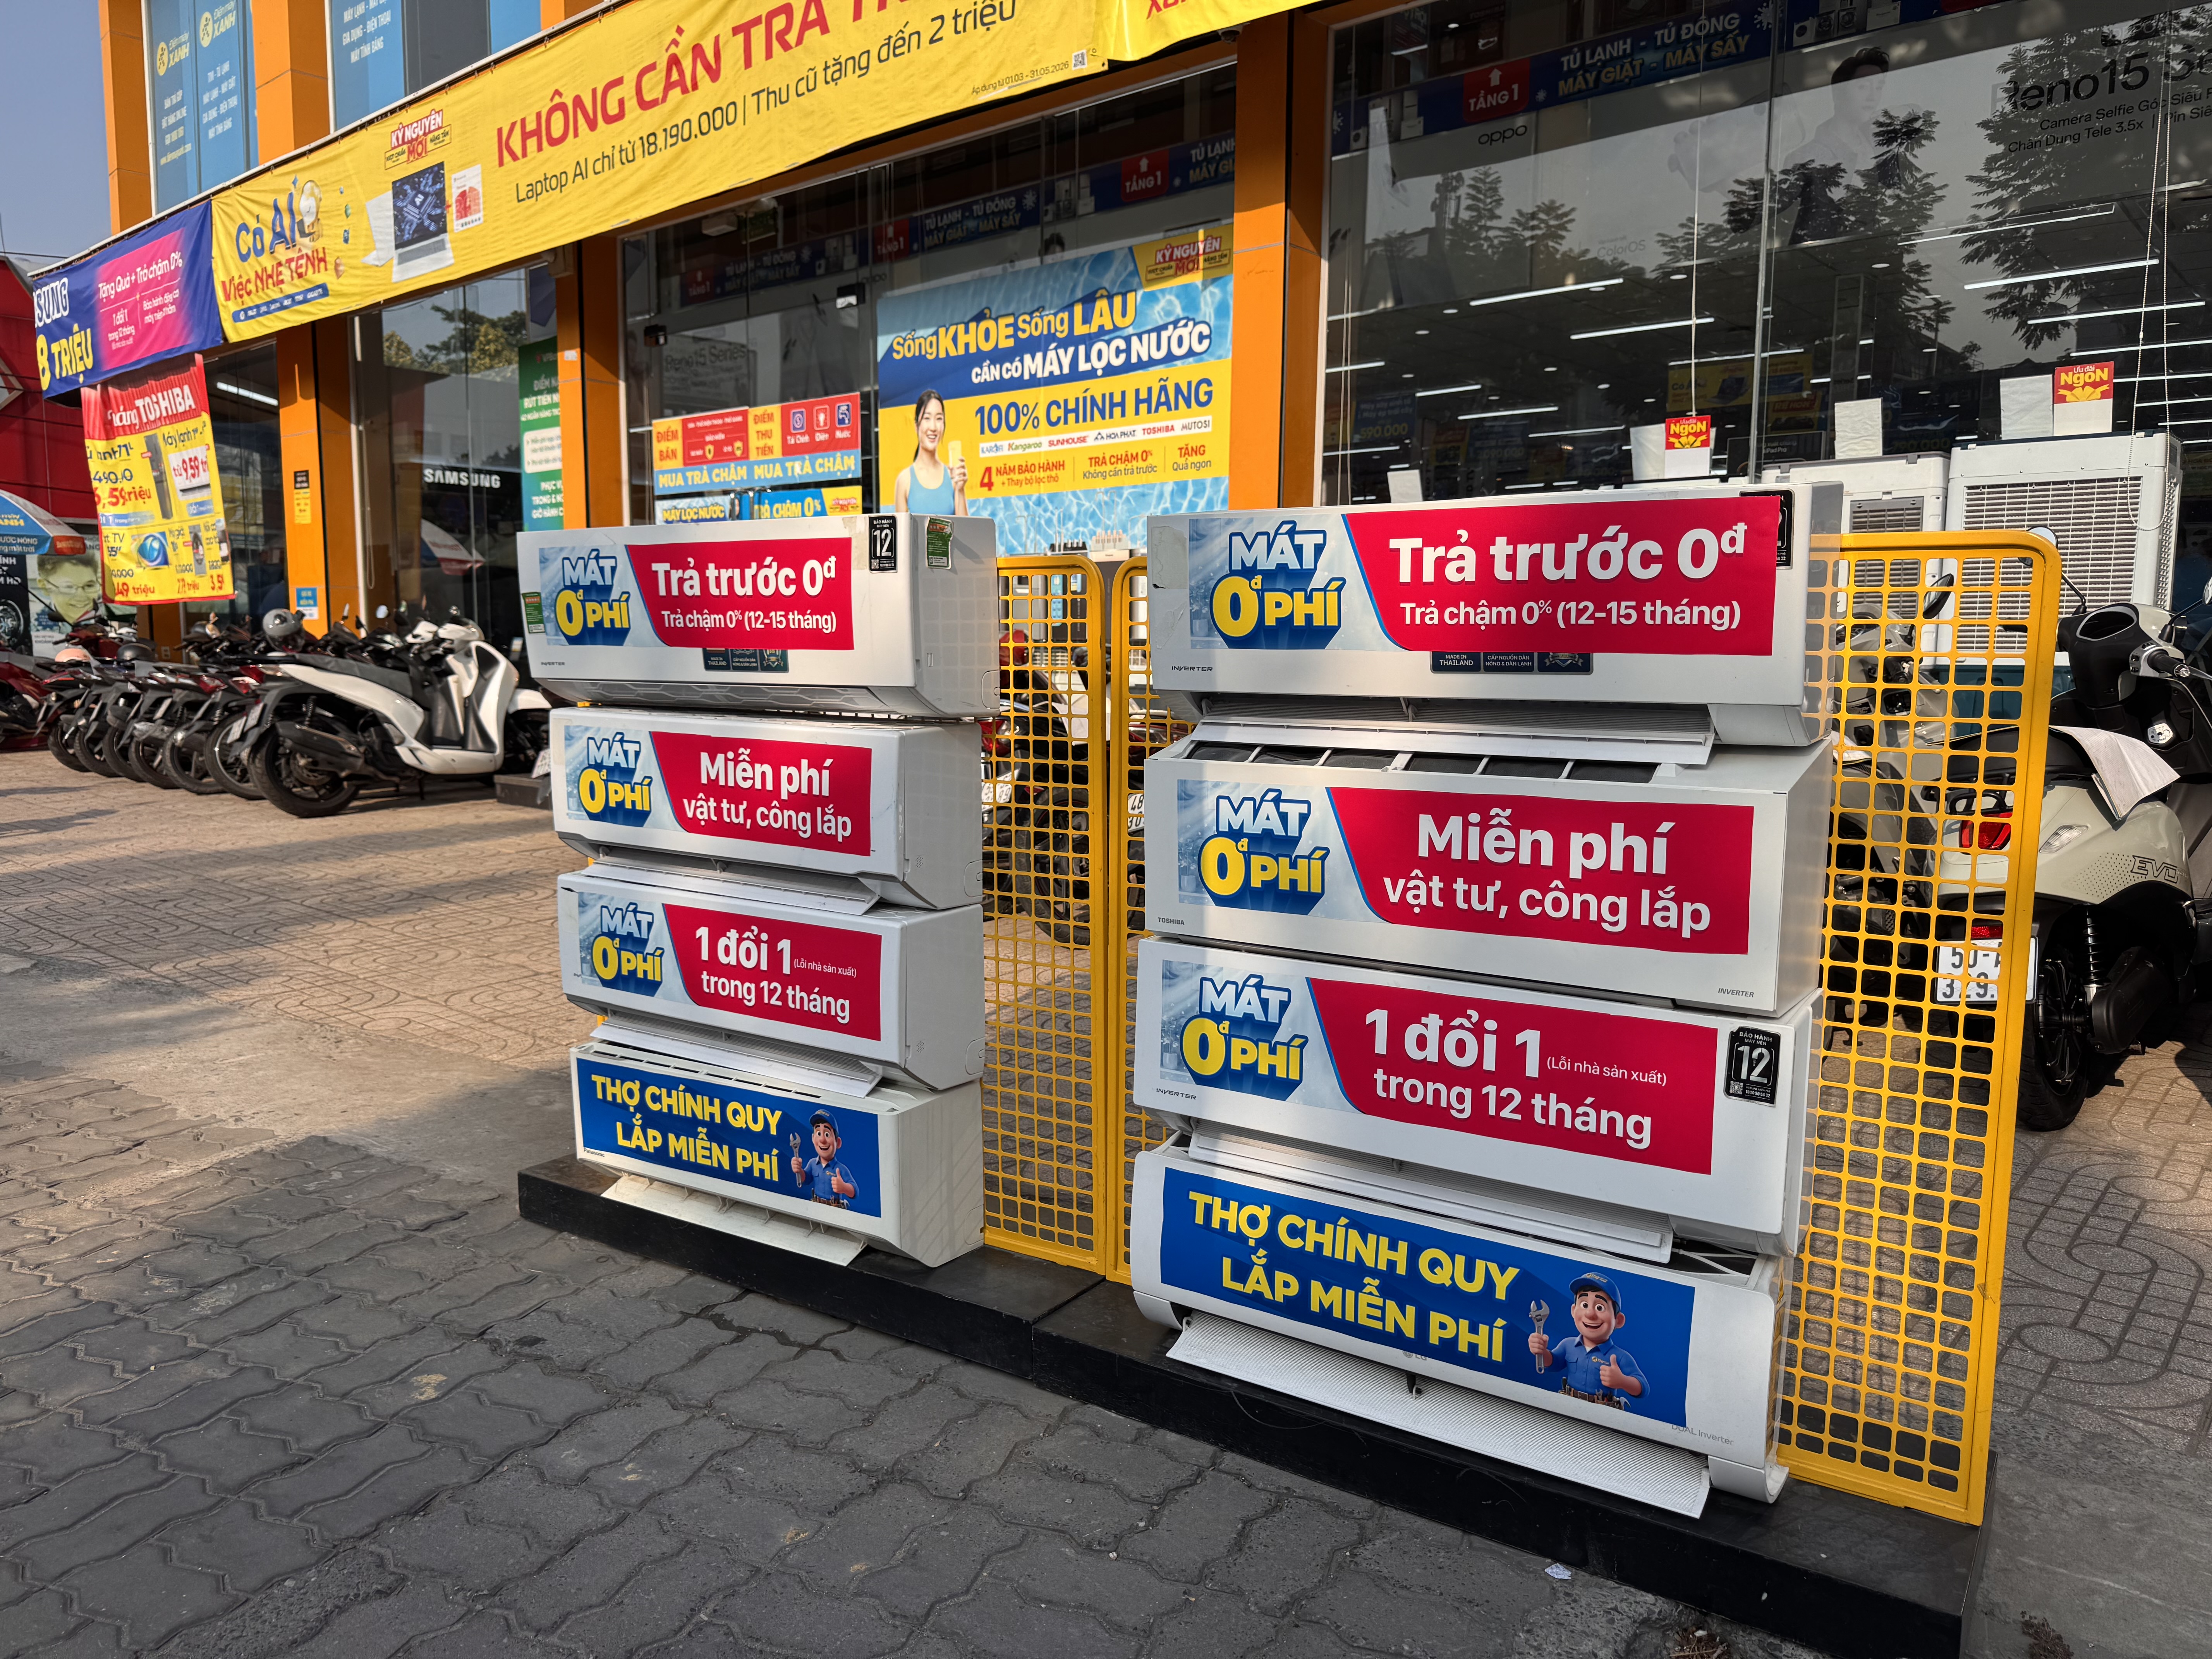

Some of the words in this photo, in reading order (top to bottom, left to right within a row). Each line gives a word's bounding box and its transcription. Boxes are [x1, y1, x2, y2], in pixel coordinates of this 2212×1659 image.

[1561, 48, 1580, 72] TỦ
[1585, 38, 1632, 65] LẠNH
[1654, 22, 1676, 46] TỦ
[1680, 12, 1740, 40] ĐÔNG
[1029, 61, 1069, 78] 31.05.2026
[1558, 72, 1597, 97] MÁY
[1600, 58, 1644, 84] GIẶT
[1665, 45, 1704, 69] MÁY
[1711, 29, 1751, 58] SẤY
[496, 76, 626, 168] KHÔNG
[635, 24, 721, 111] CẦN
[516, 170, 568, 203] Laptop
[572, 158, 588, 184] AI
[592, 146, 615, 175] chỉ
[619, 139, 636, 166] từ
[639, 102, 737, 159] 18.190.000
[751, 82, 790, 115] Thu
[795, 68, 818, 98] cũ
[823, 49, 870, 86] tặng
[878, 21, 921, 64] đến
[929, 15, 945, 45] 2
[953, 0, 1016, 34] triệu
[1469, 89, 1509, 112] TẦNG
[1511, 83, 1518, 101] 1
[2040, 113, 2091, 131] Camera
[2095, 103, 2134, 120] Selfie
[2138, 96, 2167, 112] Góc
[2171, 86, 2202, 106] Siêu
[404, 110, 443, 142] NGUYÊN
[1478, 124, 1527, 145] oppo
[2008, 139, 2042, 153] Chân
[2045, 131, 2081, 146] Dung
[2085, 122, 2111, 139] Tele
[2115, 118, 2144, 134] 3.5x
[2164, 110, 2186, 126] Pin
[236, 214, 265, 263] Có
[269, 191, 297, 254] AI
[1172, 236, 1221, 258] NGUYÊN
[98, 282, 115, 302] Tặng
[116, 271, 131, 292] Quà
[136, 263, 148, 284] Trả
[148, 258, 170, 280] chậm
[170, 251, 182, 270] 0%
[222, 274, 252, 306] Việc
[255, 261, 285, 294] NHẸ
[285, 247, 328, 279] TÊNH
[33, 277, 69, 328] SUNG
[892, 329, 938, 360] Sống
[938, 307, 1015, 358] KHỎE
[1017, 306, 1069, 338] Sống
[1073, 289, 1137, 336] LÂU
[51, 323, 94, 384] TRIỆU
[971, 361, 1000, 384] CẦN
[1001, 359, 1021, 378] CÓ
[1023, 343, 1075, 380] MÁY
[1078, 339, 1127, 376] LỌC
[1130, 319, 1211, 364] NƯỚC
[2060, 368, 2108, 387] NgoN
[135, 384, 196, 423] TOSHIBA
[753, 408, 775, 425] ĐIỂM
[975, 401, 1040, 435] 100%
[1046, 387, 1127, 427] CHÍNH
[1134, 377, 1214, 416] HÃNG
[656, 426, 679, 443] ĐIỂM
[756, 429, 773, 441] THU
[1142, 424, 1175, 435] TOSHIBA
[1181, 420, 1211, 431] MUTOSI
[1670, 421, 1707, 436] NgoN
[659, 447, 677, 461] BÁN
[756, 443, 774, 458] TIỀN
[1008, 440, 1042, 452] Kangaroo
[1048, 436, 1089, 447] SUNHOUSE
[1178, 443, 1206, 460] TẶNG
[1083, 468, 1107, 481] Không
[1108, 466, 1122, 477] cần
[1123, 464, 1135, 476] trả
[1136, 463, 1157, 475] trước
[1088, 455, 1108, 468] TRẢ
[1109, 451, 1139, 467] CHẬM
[1190, 460, 1212, 471] ngon
[424, 468, 501, 488] SAMSUNG
[659, 473, 684, 488] MUA
[686, 465, 710, 485] TRẢ
[712, 462, 747, 485] CHẬM
[980, 466, 994, 491] 4
[996, 464, 1017, 477] NĂM
[1017, 461, 1037, 474] BẢO
[1037, 460, 1065, 472] HÀNH
[1006, 476, 1024, 487] Thay
[663, 504, 681, 522] MÁY
[682, 507, 698, 523] LỌC
[698, 503, 725, 519] NƯỚC
[873, 529, 892, 557] 12
[1232, 524, 1324, 570] MÁT
[1389, 529, 1476, 583] Trả
[1490, 525, 1662, 581] trước
[1677, 522, 1748, 580] 0đ
[1264, 580, 1344, 627] PHÍ
[1400, 599, 1439, 625] Trả
[1443, 602, 1516, 630] chậm
[1522, 600, 1553, 625] 0%
[1556, 601, 1638, 629] (12-15
[1642, 598, 1741, 630] tháng)
[1417, 807, 1553, 867] Miễn
[1569, 822, 1676, 879] phí
[2130, 855, 2179, 884] EVO
[1383, 869, 1444, 913] vật
[1453, 877, 1508, 919] tư,
[1519, 881, 1627, 932] công
[1640, 885, 1710, 938] lắp
[1157, 917, 1185, 926] TOSHIBA
[793, 957, 807, 970] (Lỗi
[807, 960, 821, 971] nhà
[822, 962, 836, 974] sản
[837, 964, 857, 979] xuất)
[1717, 988, 1754, 998] INVERTER
[1365, 1009, 1388, 1055] 1
[1404, 1009, 1497, 1072] đổi
[1515, 1029, 1540, 1079] 1
[1547, 1056, 1571, 1072] (Lỗi
[1573, 1058, 1601, 1075] nhà
[1602, 1063, 1628, 1079] sản
[1631, 1067, 1667, 1087] xuất)
[1754, 1034, 1772, 1042] HÀNH
[1737, 1045, 1770, 1084] 12
[1156, 1088, 1197, 1100] INVERTER
[1373, 1068, 1472, 1119] trong
[1481, 1084, 1522, 1120] 12
[1531, 1093, 1652, 1149] tháng
[583, 1147, 605, 1158] Panasonic
[1188, 1191, 1271, 1246] THỢ
[1278, 1216, 1408, 1276] CHÍNH
[1418, 1247, 1520, 1301] QUY
[1222, 1249, 1299, 1301] LẮP
[1310, 1277, 1416, 1339] MIỄN
[1428, 1310, 1507, 1362] PHÍ
[1698, 1429, 1734, 1446] Inverter
